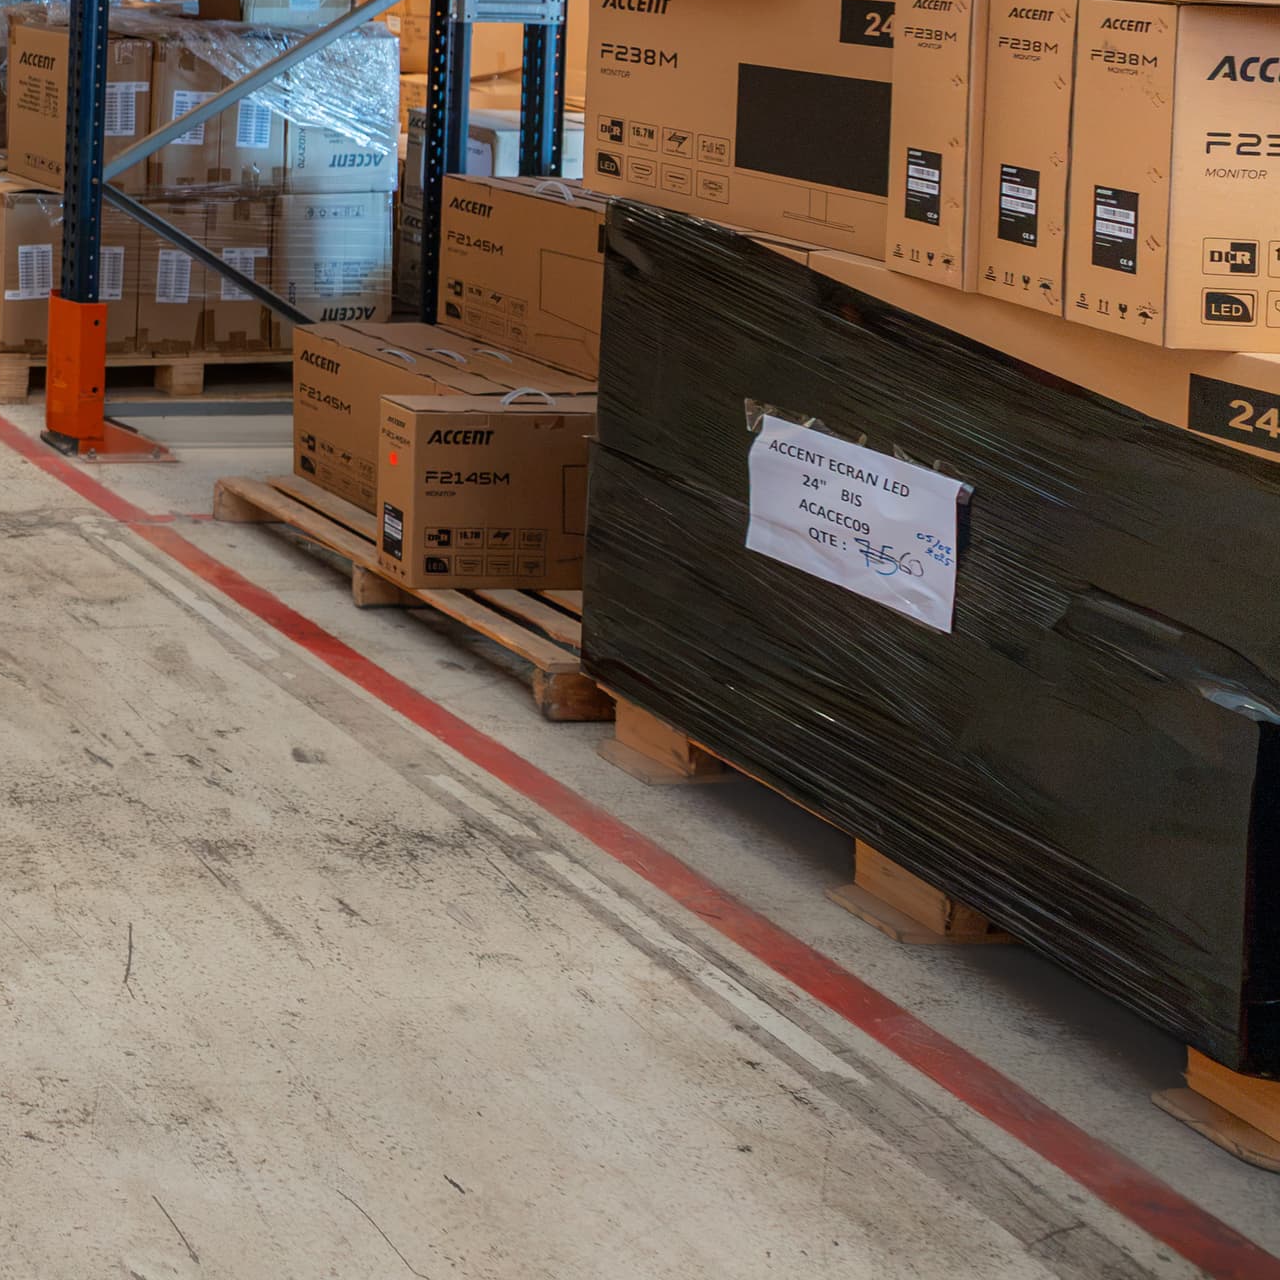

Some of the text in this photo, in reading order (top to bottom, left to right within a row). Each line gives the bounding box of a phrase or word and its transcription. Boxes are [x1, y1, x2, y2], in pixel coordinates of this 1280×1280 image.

[1008, 6, 1055, 22] ACCENT
[904, 26, 958, 43] F238M
[1100, 16, 1152, 35] ACCENT
[600, 42, 679, 69] F238M
[998, 36, 1059, 56] F238M
[19, 51, 56, 71] ACCENT
[1090, 48, 1159, 69] F238M
[1206, 55, 1280, 85] ACC
[329, 153, 385, 168] ACCENT
[1204, 167, 1268, 181] MONITOR
[450, 196, 494, 219] ACCENT
[447, 230, 505, 256] F2145M
[1209, 248, 1251, 266] DCR
[321, 306, 377, 321] ACCENT
[1210, 303, 1243, 318] LED
[300, 349, 341, 375] ACCENT
[299, 382, 352, 415] F2145M
[1227, 397, 1280, 438] 24
[427, 429, 494, 446] ACCENT
[425, 470, 511, 485] F2145M
[769, 439, 910, 498] ACCENT ECRAN LED
[802, 474, 863, 507] 24" BIS
[799, 498, 870, 535] ACACEC09
